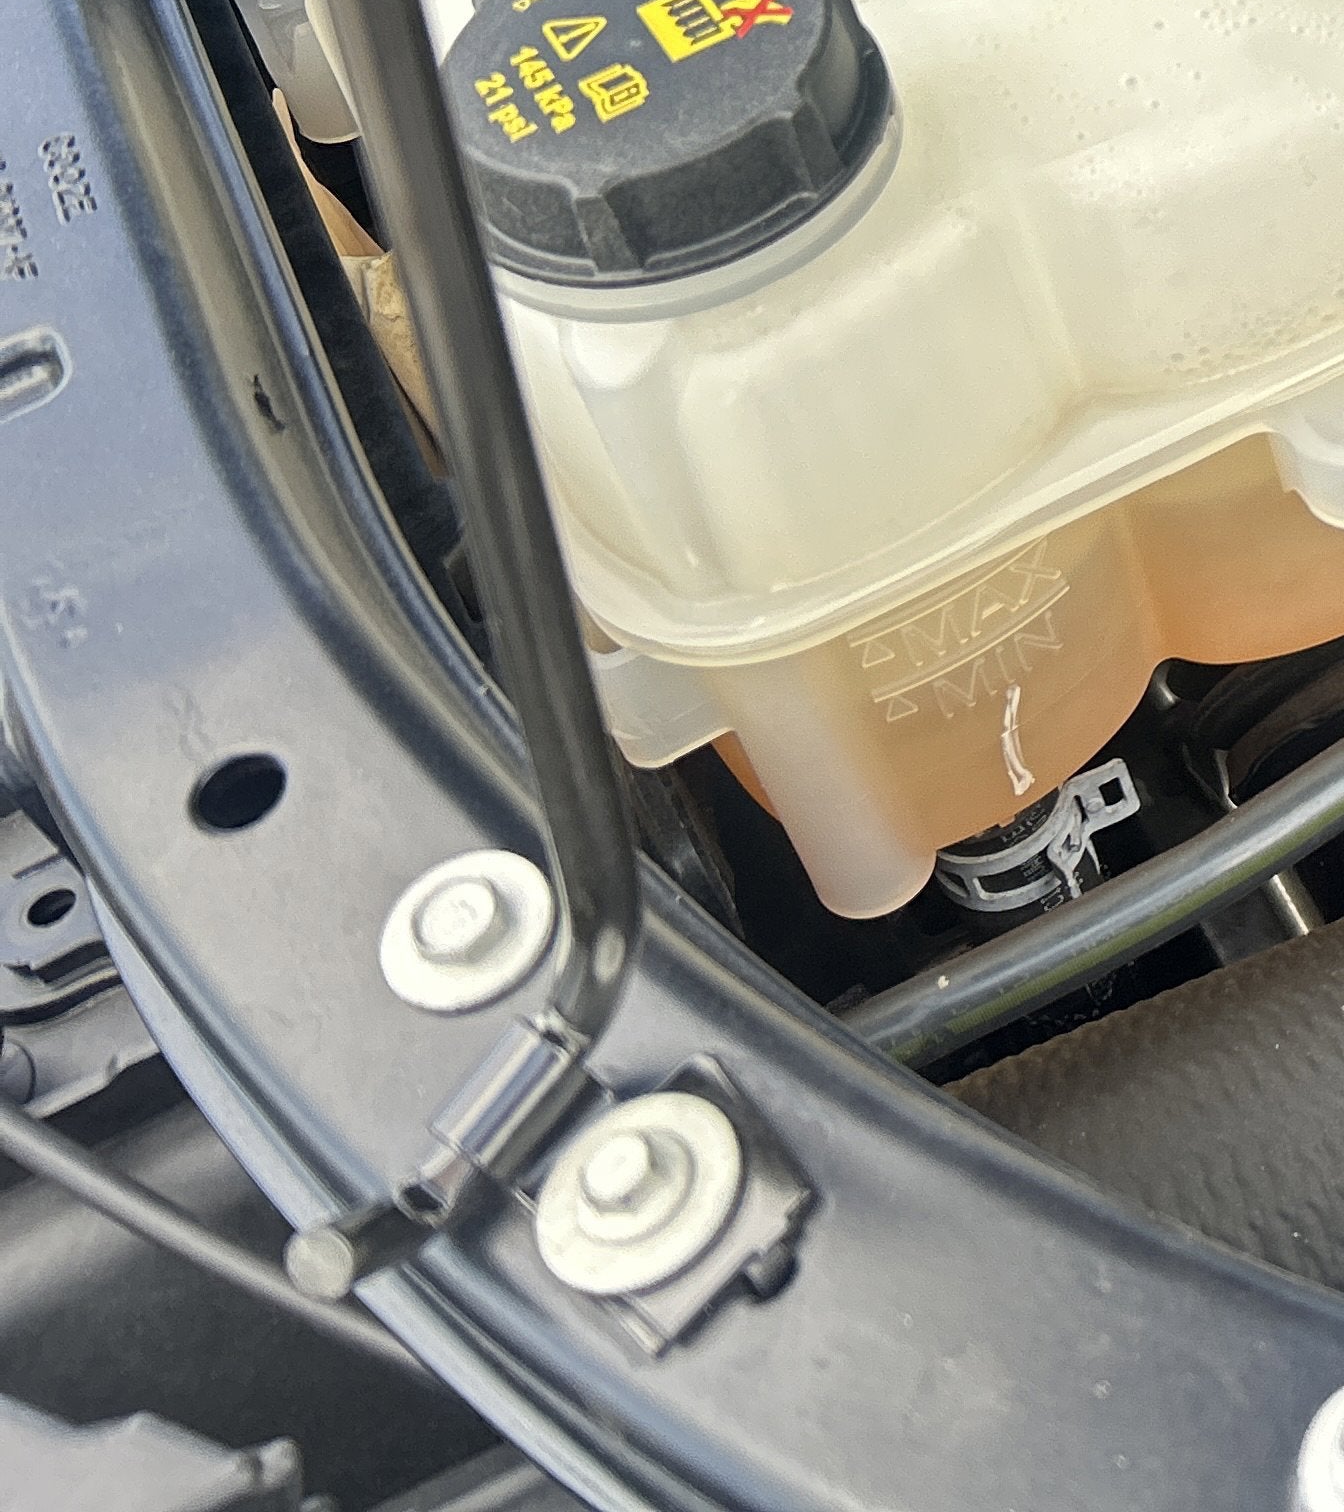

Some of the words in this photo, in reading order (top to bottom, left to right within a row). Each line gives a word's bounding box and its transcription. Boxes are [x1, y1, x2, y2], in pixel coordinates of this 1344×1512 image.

[478, 72, 514, 107] 21
[488, 103, 539, 143] psi
[510, 46, 555, 89] 145
[534, 84, 576, 133] kPa
[898, 539, 1062, 666] MAX
[930, 610, 1065, 719] MIN
